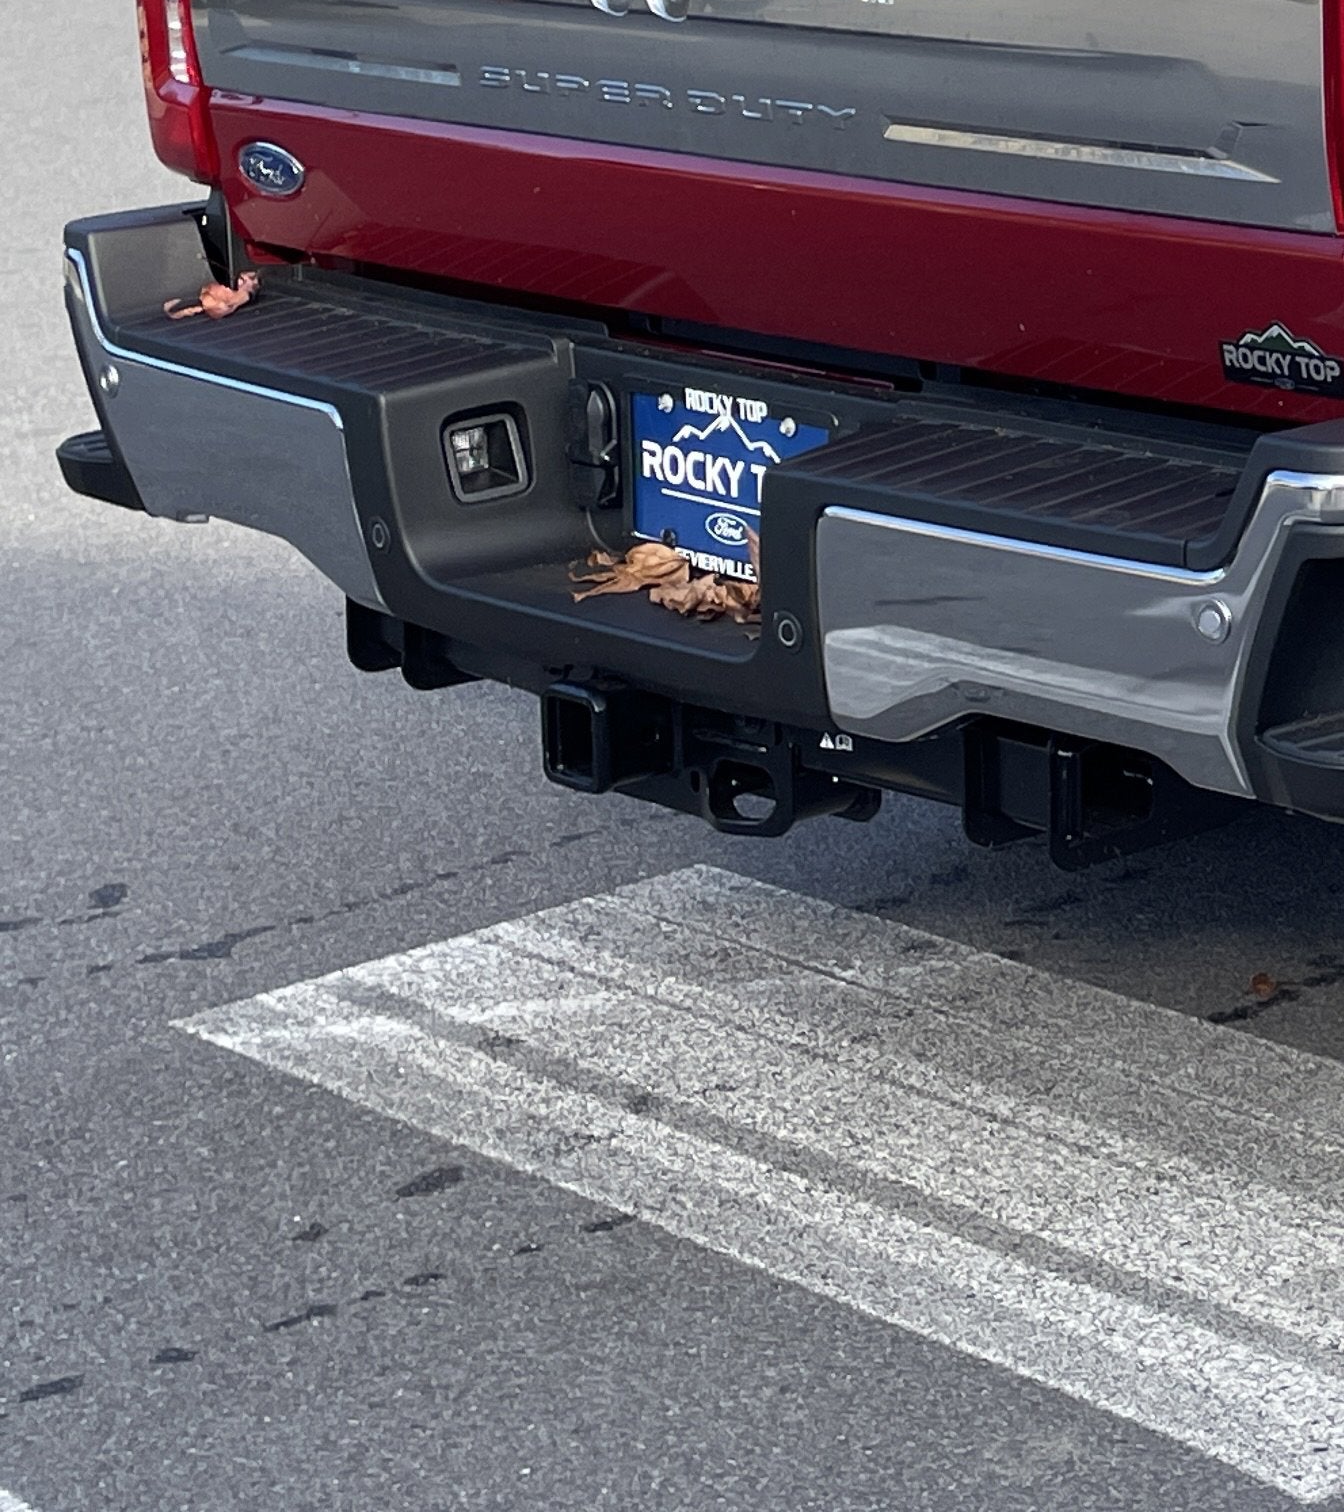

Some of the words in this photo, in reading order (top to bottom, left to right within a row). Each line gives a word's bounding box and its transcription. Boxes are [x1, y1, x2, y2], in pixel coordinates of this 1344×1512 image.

[479, 66, 673, 110] SUPER
[686, 88, 857, 131] DUTY
[1222, 343, 1292, 376] ROCKY
[1294, 356, 1341, 383] TOP
[684, 387, 733, 418] ROCKY
[736, 397, 768, 424] TOP
[641, 439, 746, 499] ROCKY
